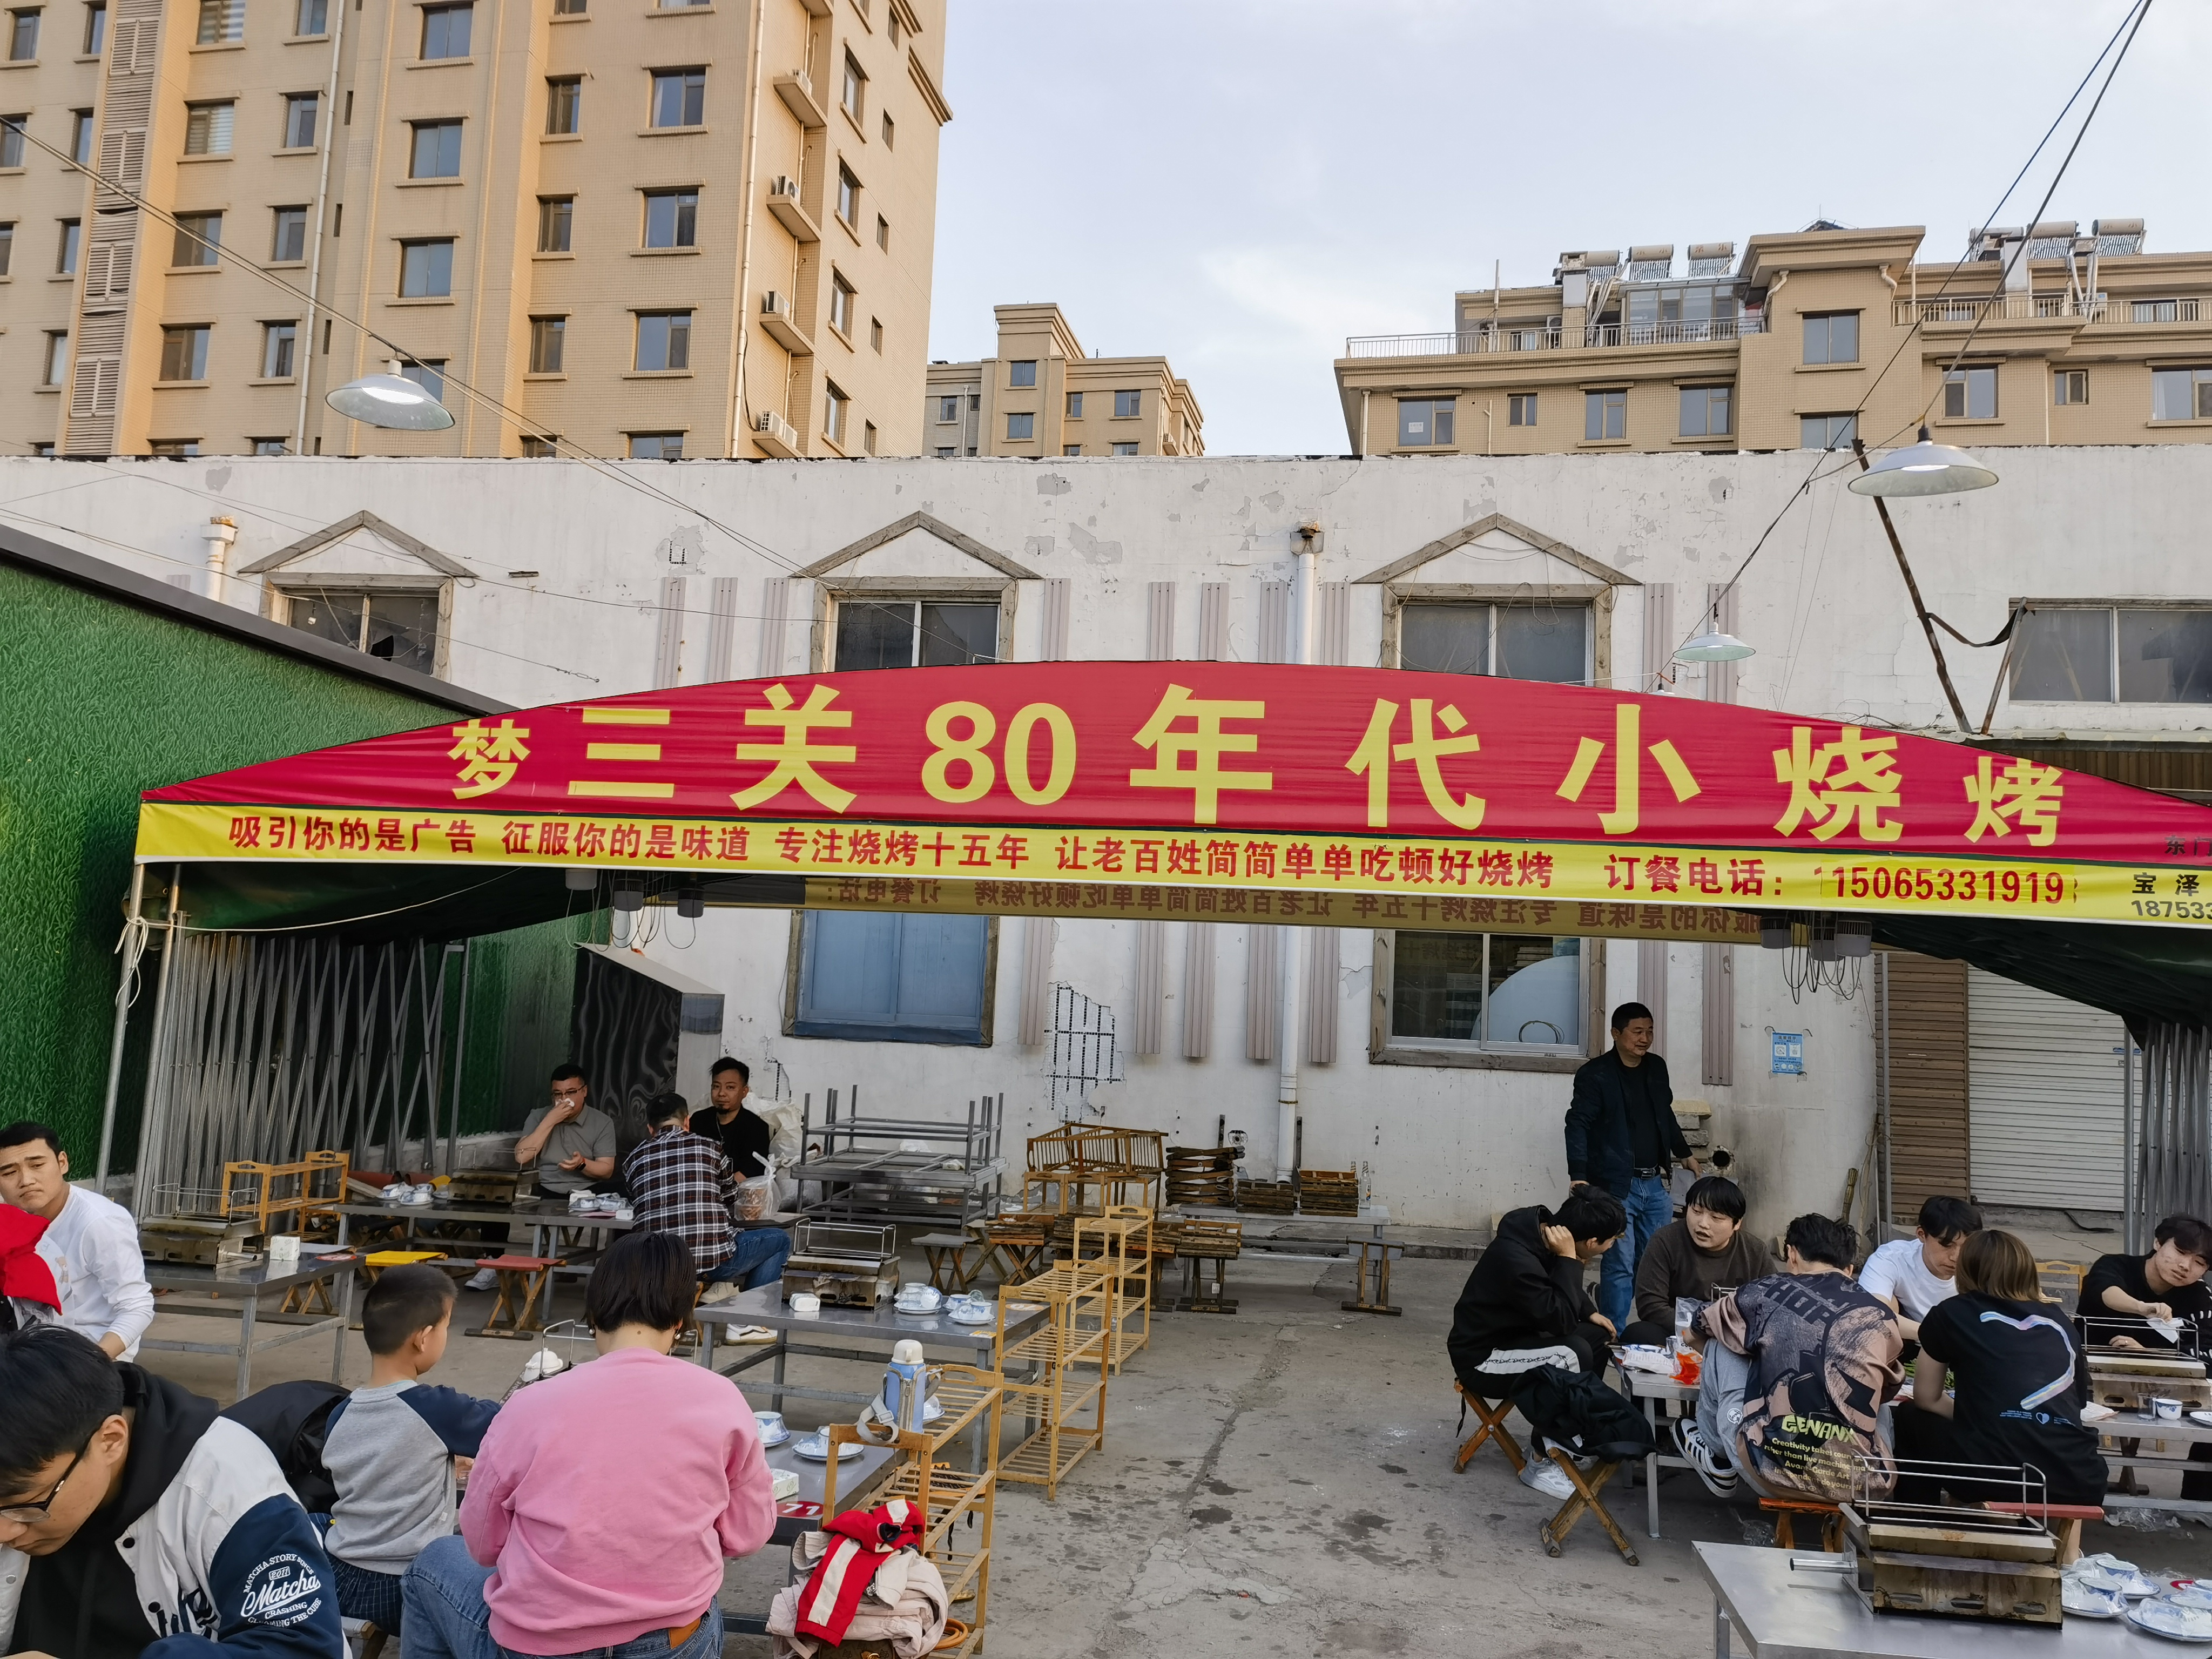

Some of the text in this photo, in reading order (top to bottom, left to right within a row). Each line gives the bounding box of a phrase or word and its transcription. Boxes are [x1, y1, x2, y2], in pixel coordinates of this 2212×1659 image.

[230, 817, 2063, 903] 吸引你的是广告 征服你的是味道 专注烧烤十五年 让老百姓简简单单吃顿好烧烤 订餐电话： 15065331919
[1772, 1438, 1810, 1452] Creativity
[1811, 1446, 1832, 1456] takes
[1784, 1451, 1802, 1460] than
[1804, 1454, 1817, 1463] live
[1837, 1471, 1851, 1480] Art
[782, 1503, 820, 1515] 71
[244, 1553, 314, 1593] MATCHA STORY SINCE
[271, 1568, 288, 1579] 2011
[240, 1569, 321, 1617] Matcha
[265, 1602, 307, 1619] CRASHING
[290, 1612, 308, 1623] THE
[307, 1597, 321, 1615] CUBE
